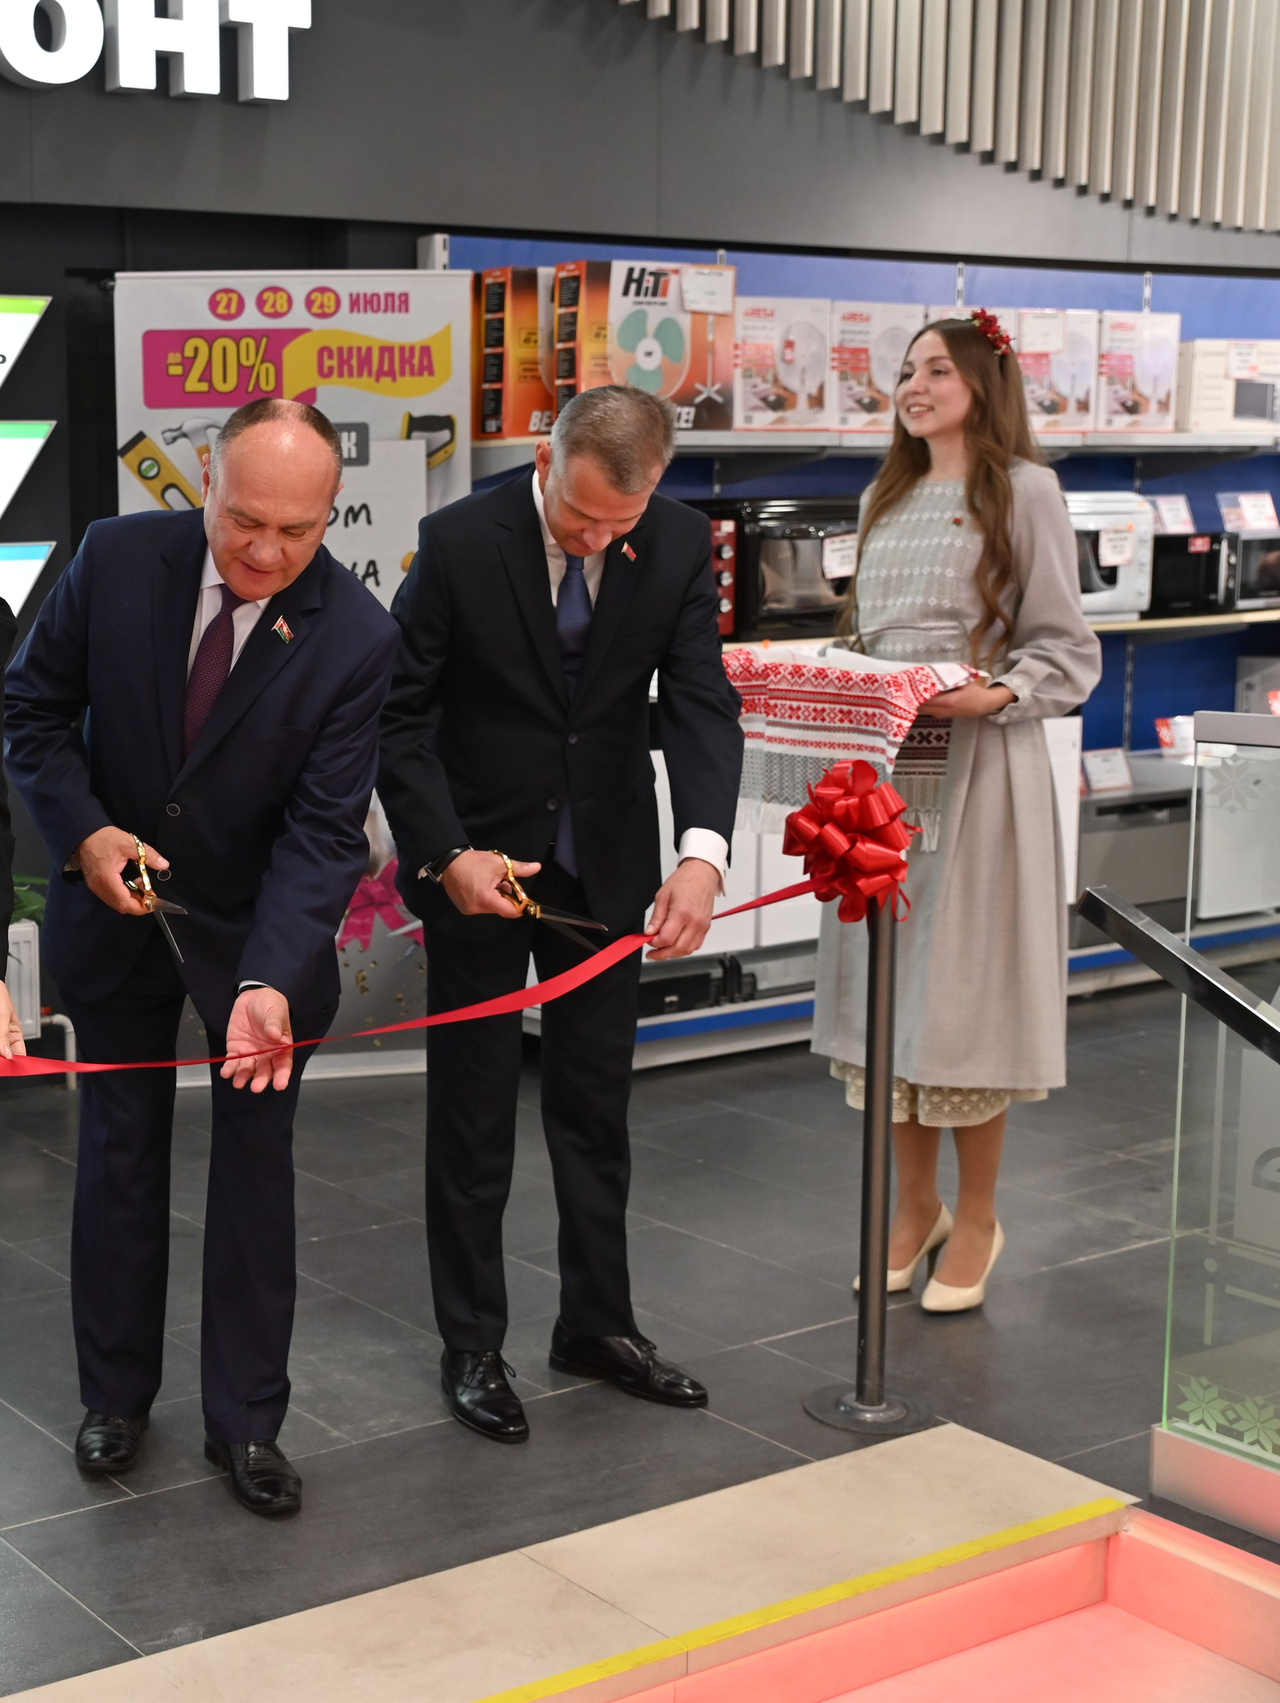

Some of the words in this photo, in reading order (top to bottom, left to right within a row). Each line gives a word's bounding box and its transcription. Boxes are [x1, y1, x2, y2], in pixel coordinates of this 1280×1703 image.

[215, 292, 238, 315] 27
[262, 291, 289, 314] 28
[309, 291, 337, 314] 29
[348, 292, 410, 314] ИЮЛЯ
[167, 335, 277, 393] -20%
[316, 345, 436, 383] СКИДКА
